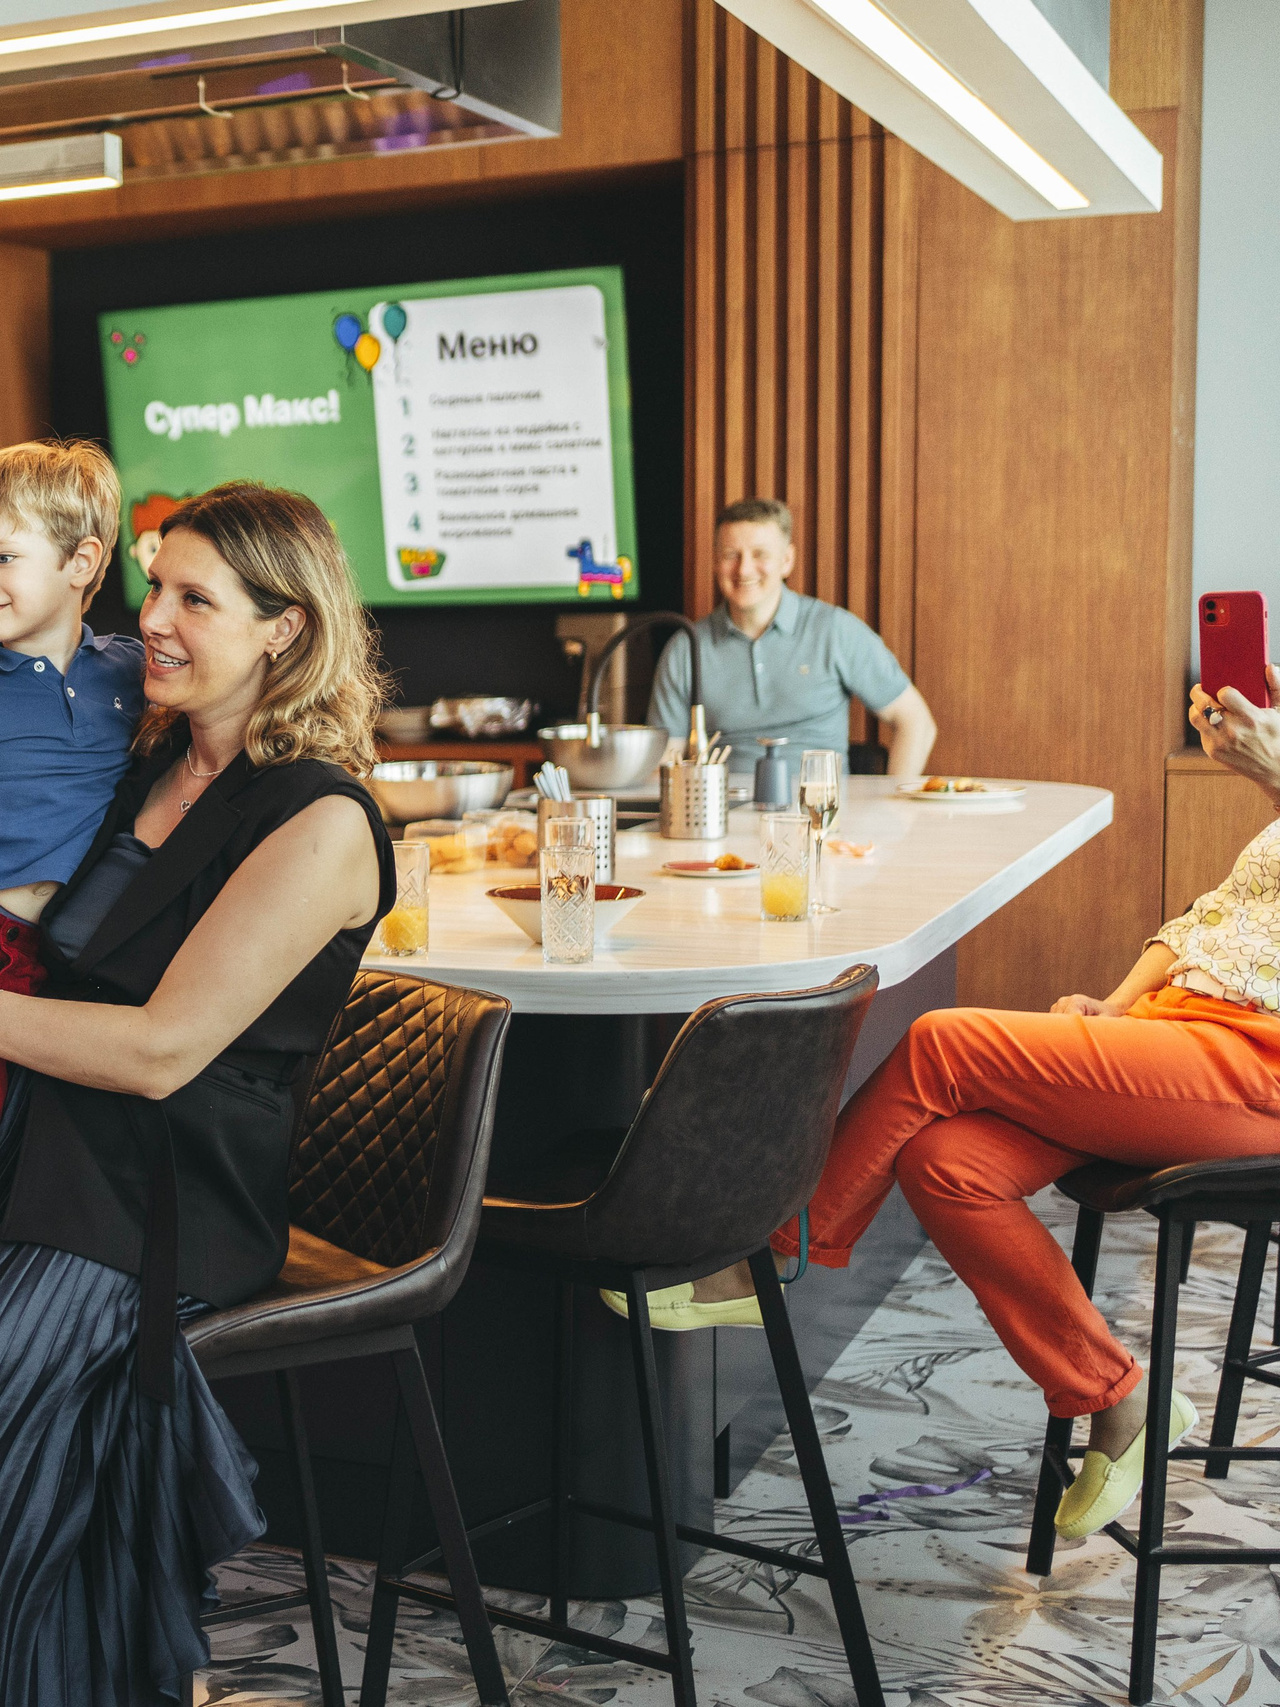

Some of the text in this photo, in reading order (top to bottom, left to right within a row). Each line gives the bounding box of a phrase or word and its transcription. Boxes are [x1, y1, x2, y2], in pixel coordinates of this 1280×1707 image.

[437, 331, 538, 361] Меню
[145, 389, 340, 440] Супер Макс!
[400, 396, 411, 416] 1
[402, 434, 416, 456] 2
[404, 472, 419, 494] 3
[408, 511, 421, 532] 4
